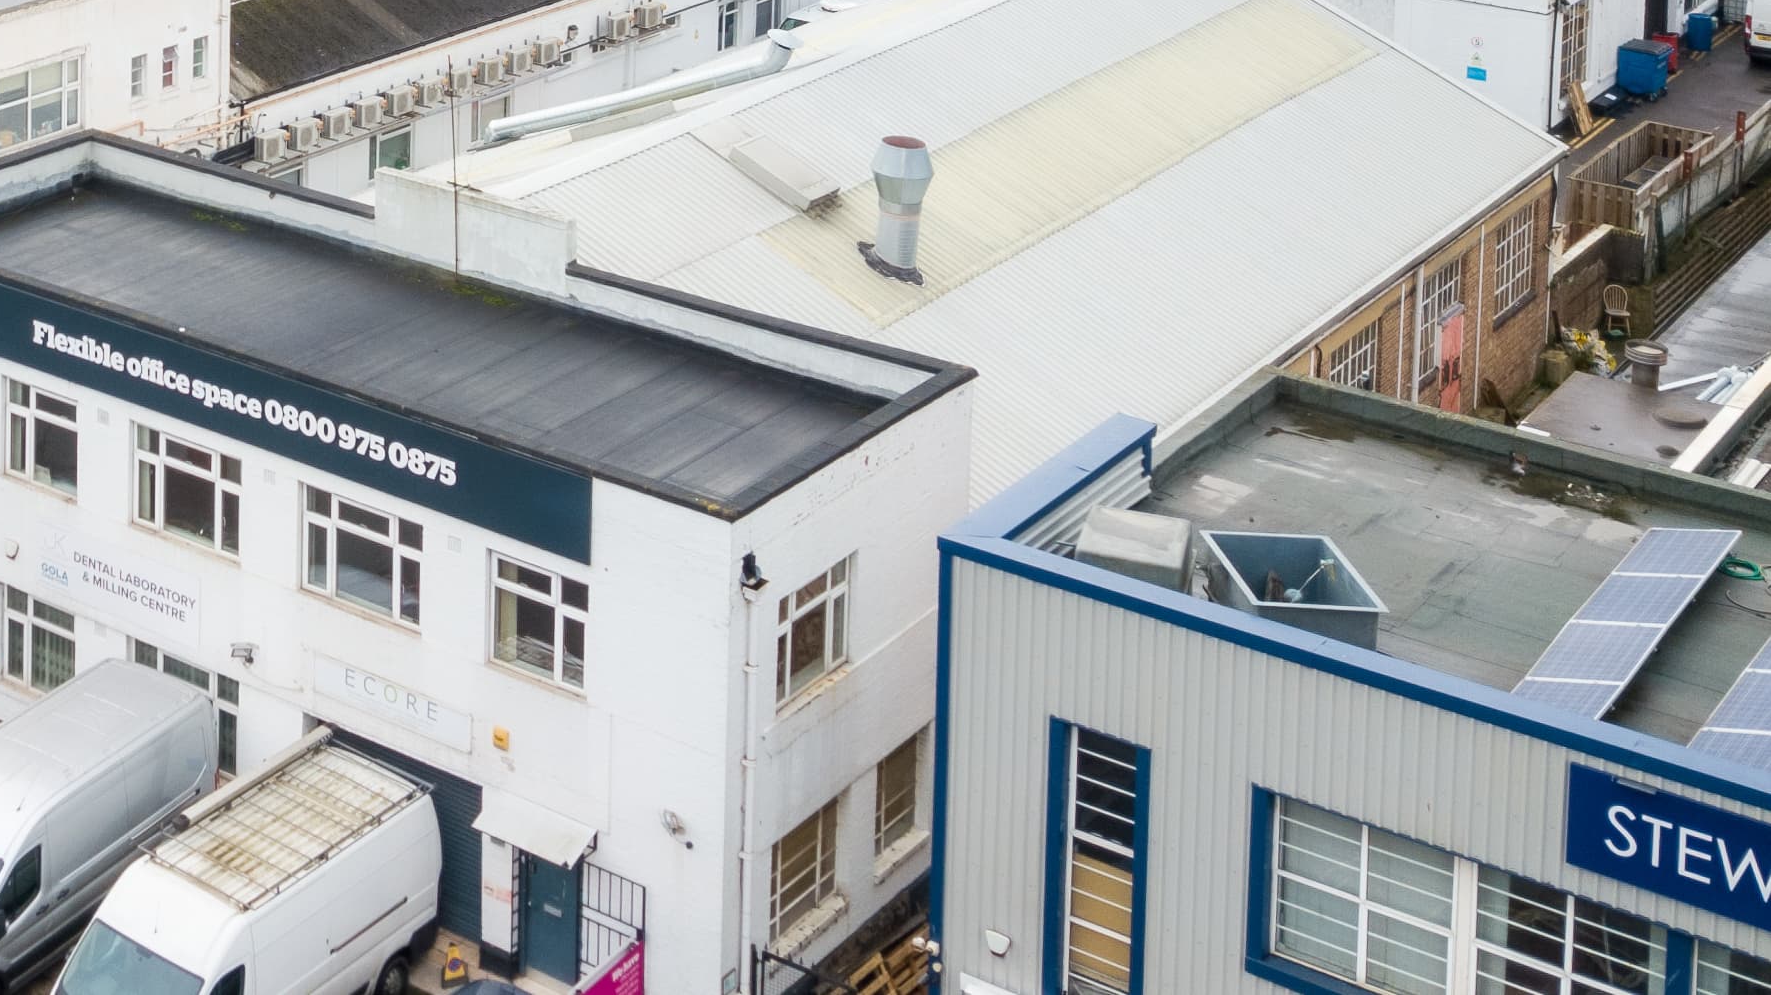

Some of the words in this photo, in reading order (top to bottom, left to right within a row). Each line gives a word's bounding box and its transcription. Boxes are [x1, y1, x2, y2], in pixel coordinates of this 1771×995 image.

[32, 319, 125, 372] Flexible
[126, 356, 189, 395] office
[191, 379, 262, 420] space
[264, 399, 336, 444] 0800
[337, 423, 386, 462] 975
[388, 442, 457, 486] 0875
[41, 562, 68, 581] GOLA
[73, 551, 115, 578] DENTAL
[120, 570, 197, 611] LABORATORY
[82, 571, 90, 582] &
[93, 575, 137, 603] MILLING
[140, 595, 187, 622] CENTRE
[344, 668, 438, 722] ECORE
[1604, 805, 1771, 904] STEW
